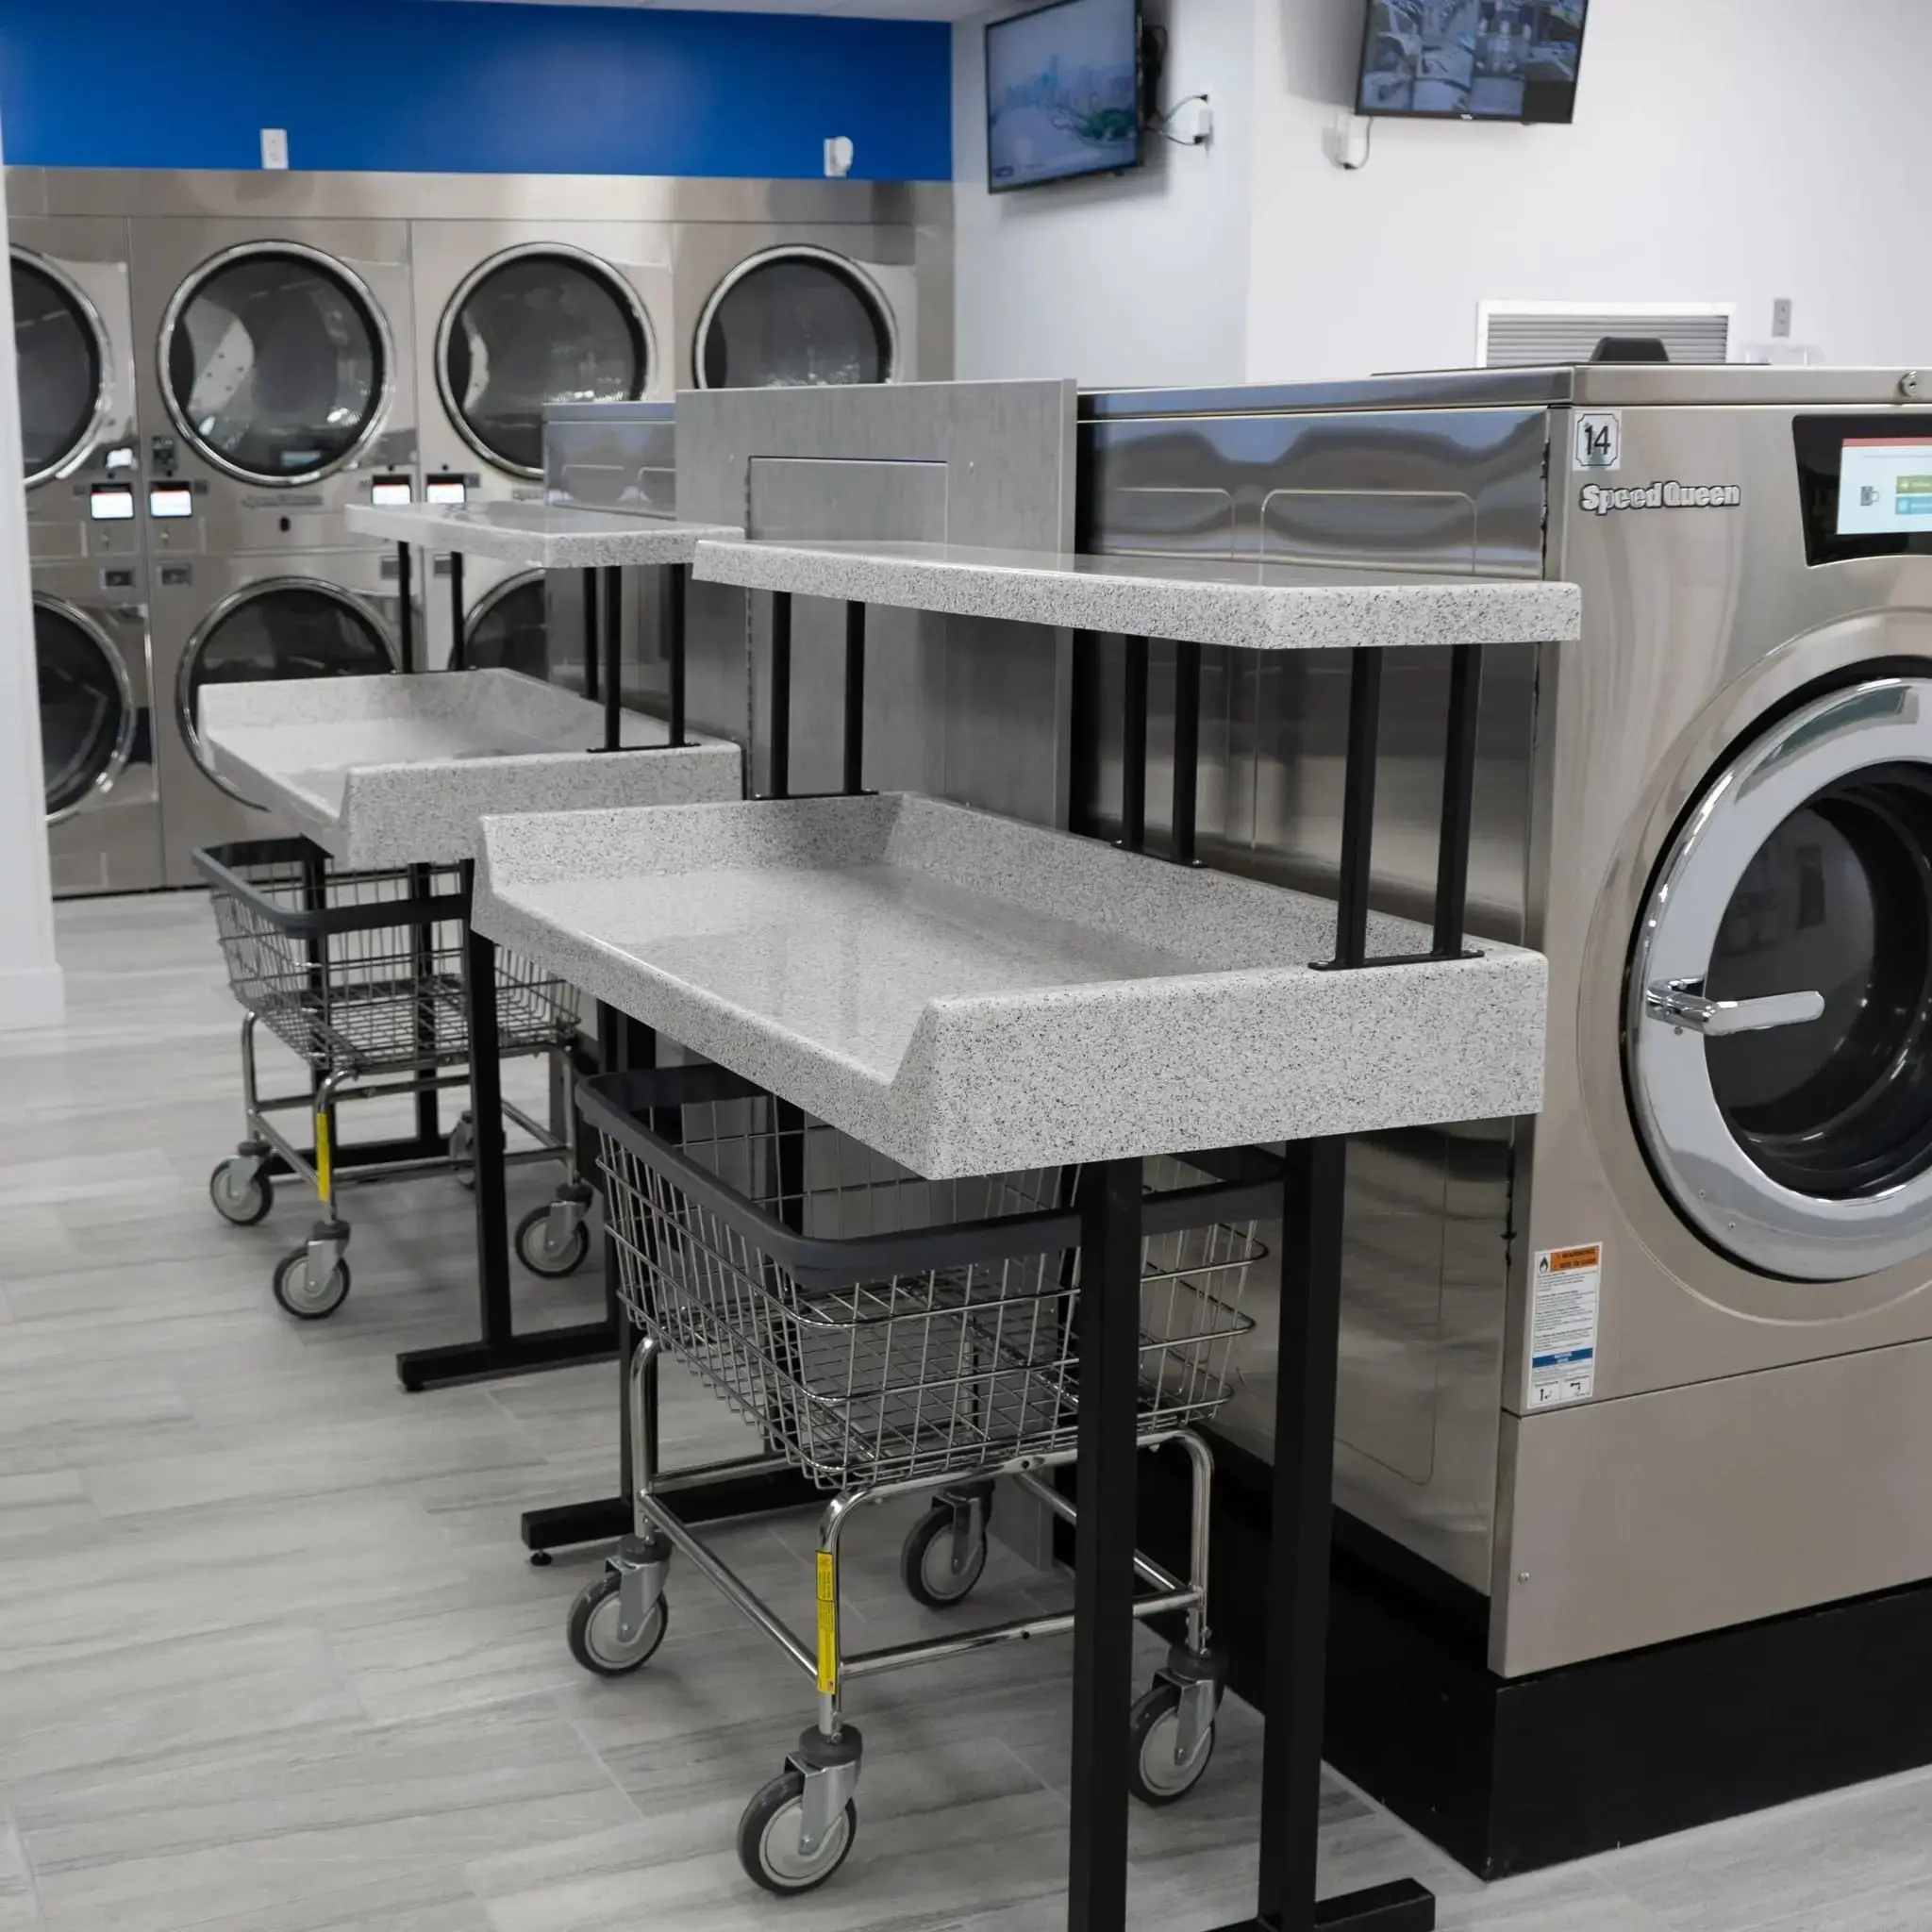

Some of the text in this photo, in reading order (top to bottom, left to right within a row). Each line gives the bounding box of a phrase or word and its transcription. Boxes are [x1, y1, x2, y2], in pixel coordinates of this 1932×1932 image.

[1585, 425, 1611, 455] 14
[1580, 480, 1741, 516] Speed Queen
